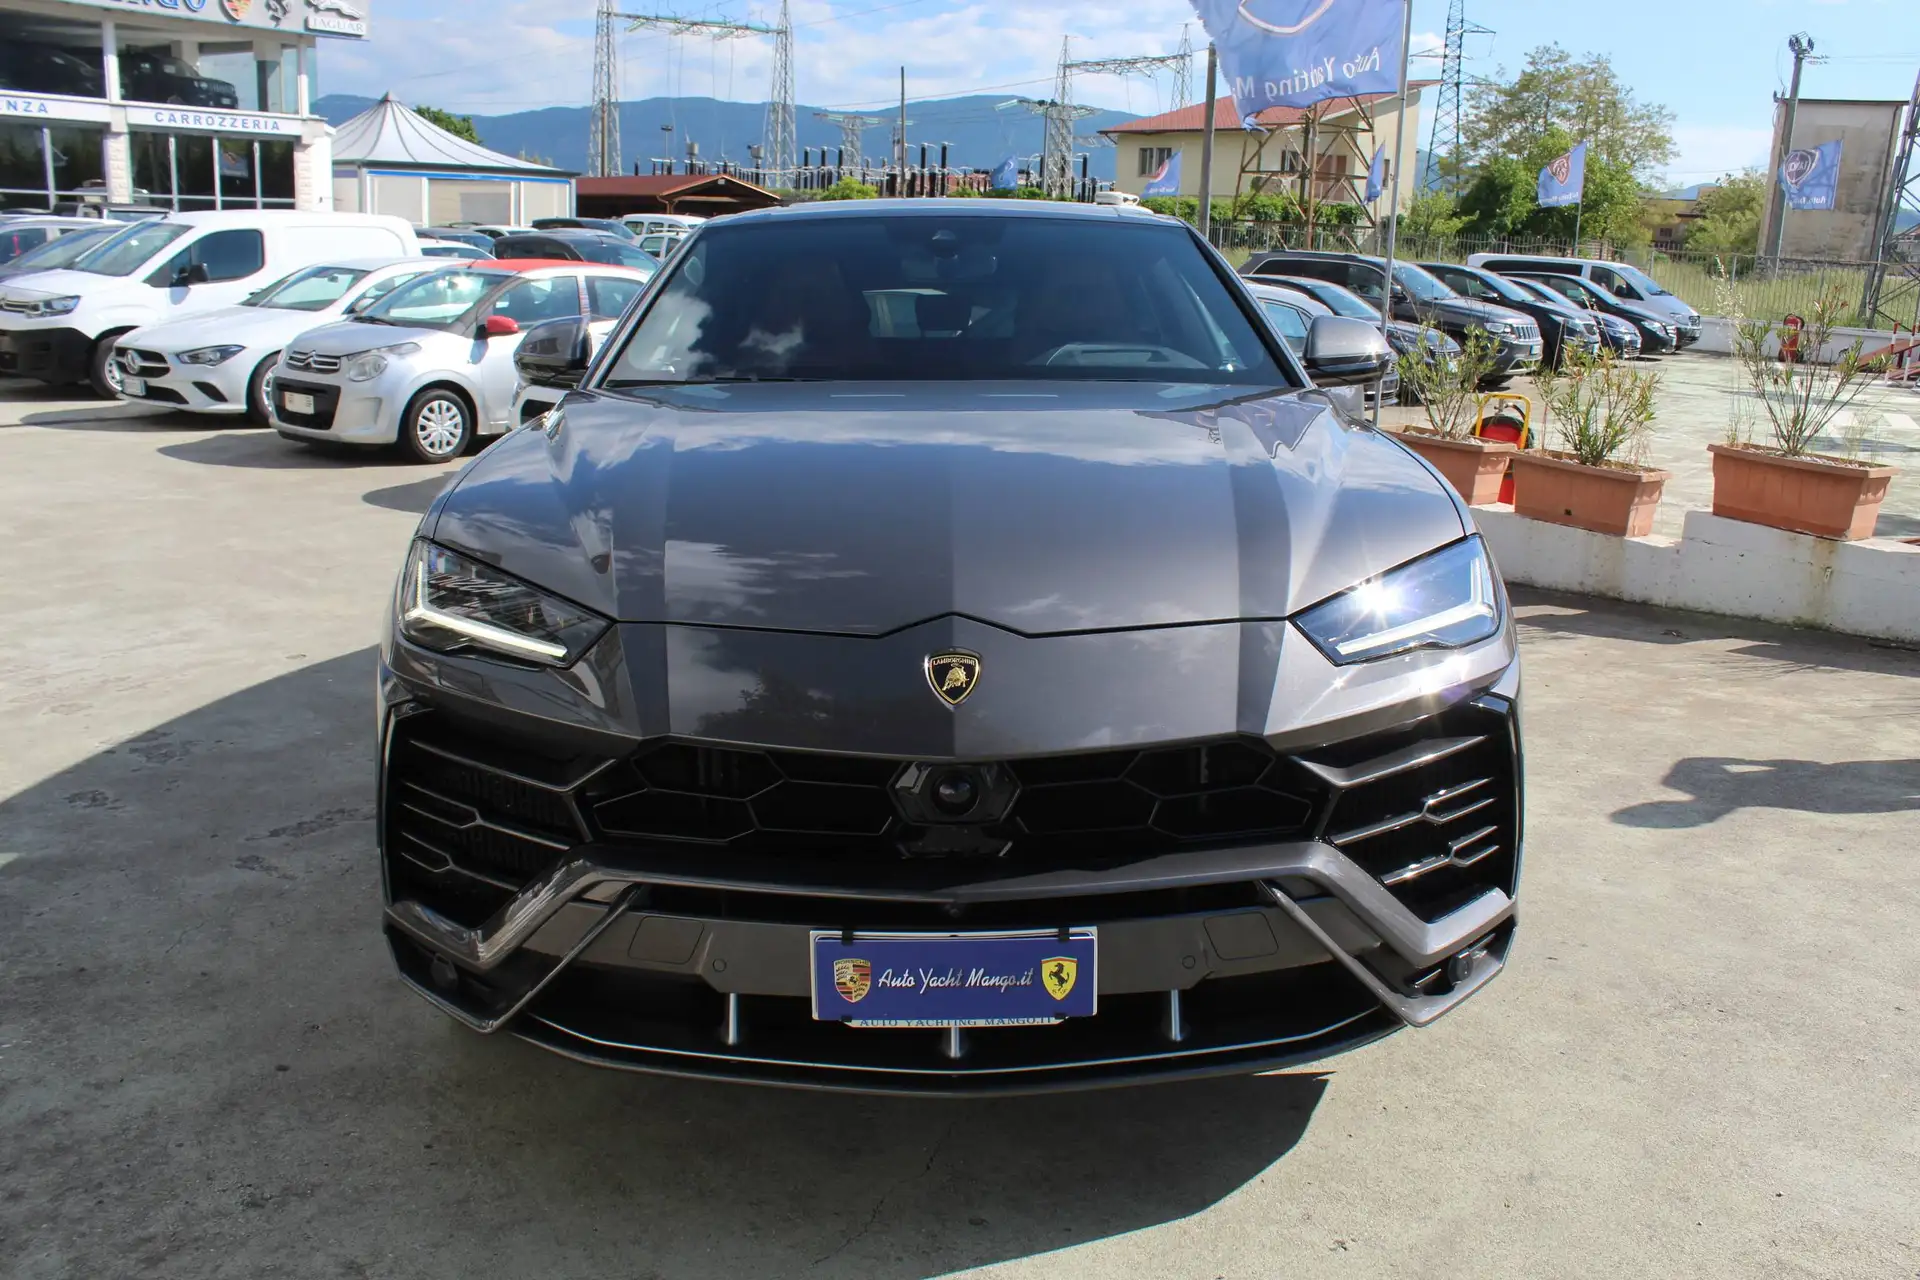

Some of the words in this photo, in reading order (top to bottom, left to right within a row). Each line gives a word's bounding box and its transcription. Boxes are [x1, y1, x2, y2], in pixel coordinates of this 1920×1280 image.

[312, 17, 364, 33] JAGUAR
[0, 100, 48, 114] NZA
[154, 112, 280, 131] CARROZZERIA
[933, 657, 975, 666] LAMBORGHINI
[878, 968, 915, 988] Auto
[919, 967, 963, 994] Yacht
[965, 967, 1034, 993] Mango.it
[859, 1019, 898, 1027] AUTO
